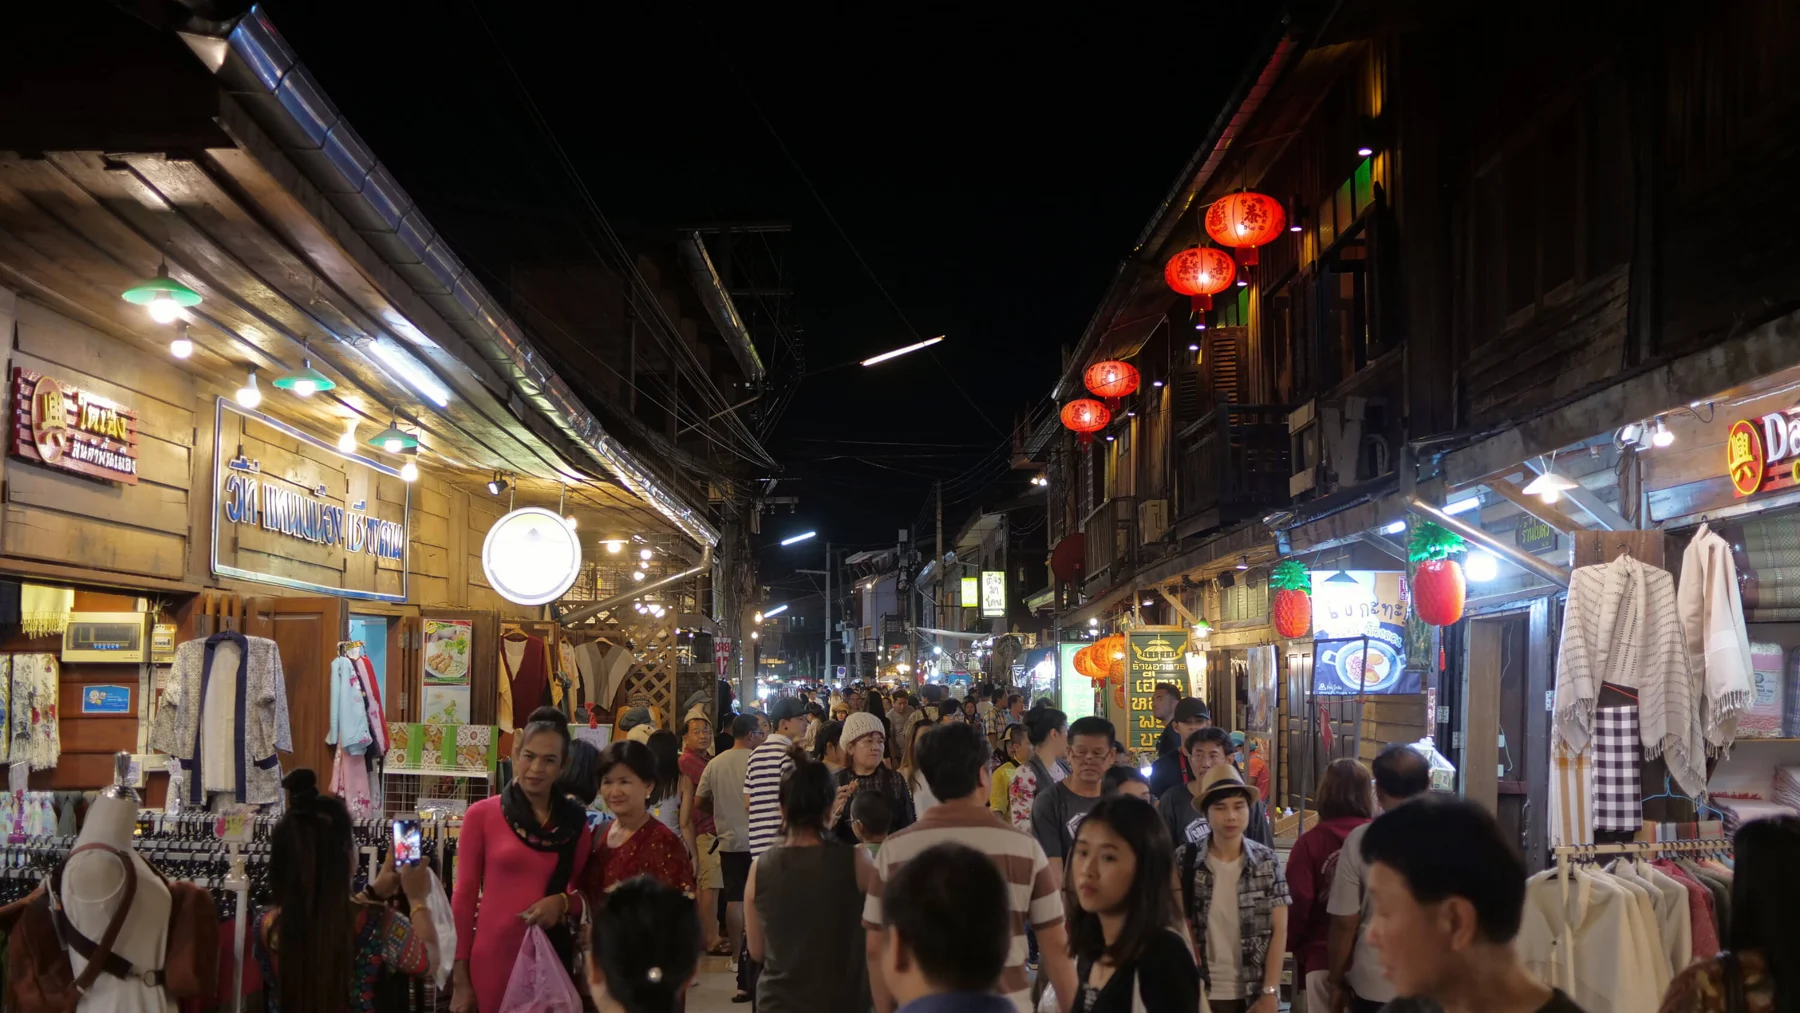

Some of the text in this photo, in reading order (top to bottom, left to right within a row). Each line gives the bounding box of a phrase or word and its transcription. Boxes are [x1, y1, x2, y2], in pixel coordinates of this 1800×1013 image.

[345, 499, 404, 561] เชียงคาน
[1132, 661, 1186, 671] ร้านอาหาร
[1136, 671, 1184, 693] เฮืน
